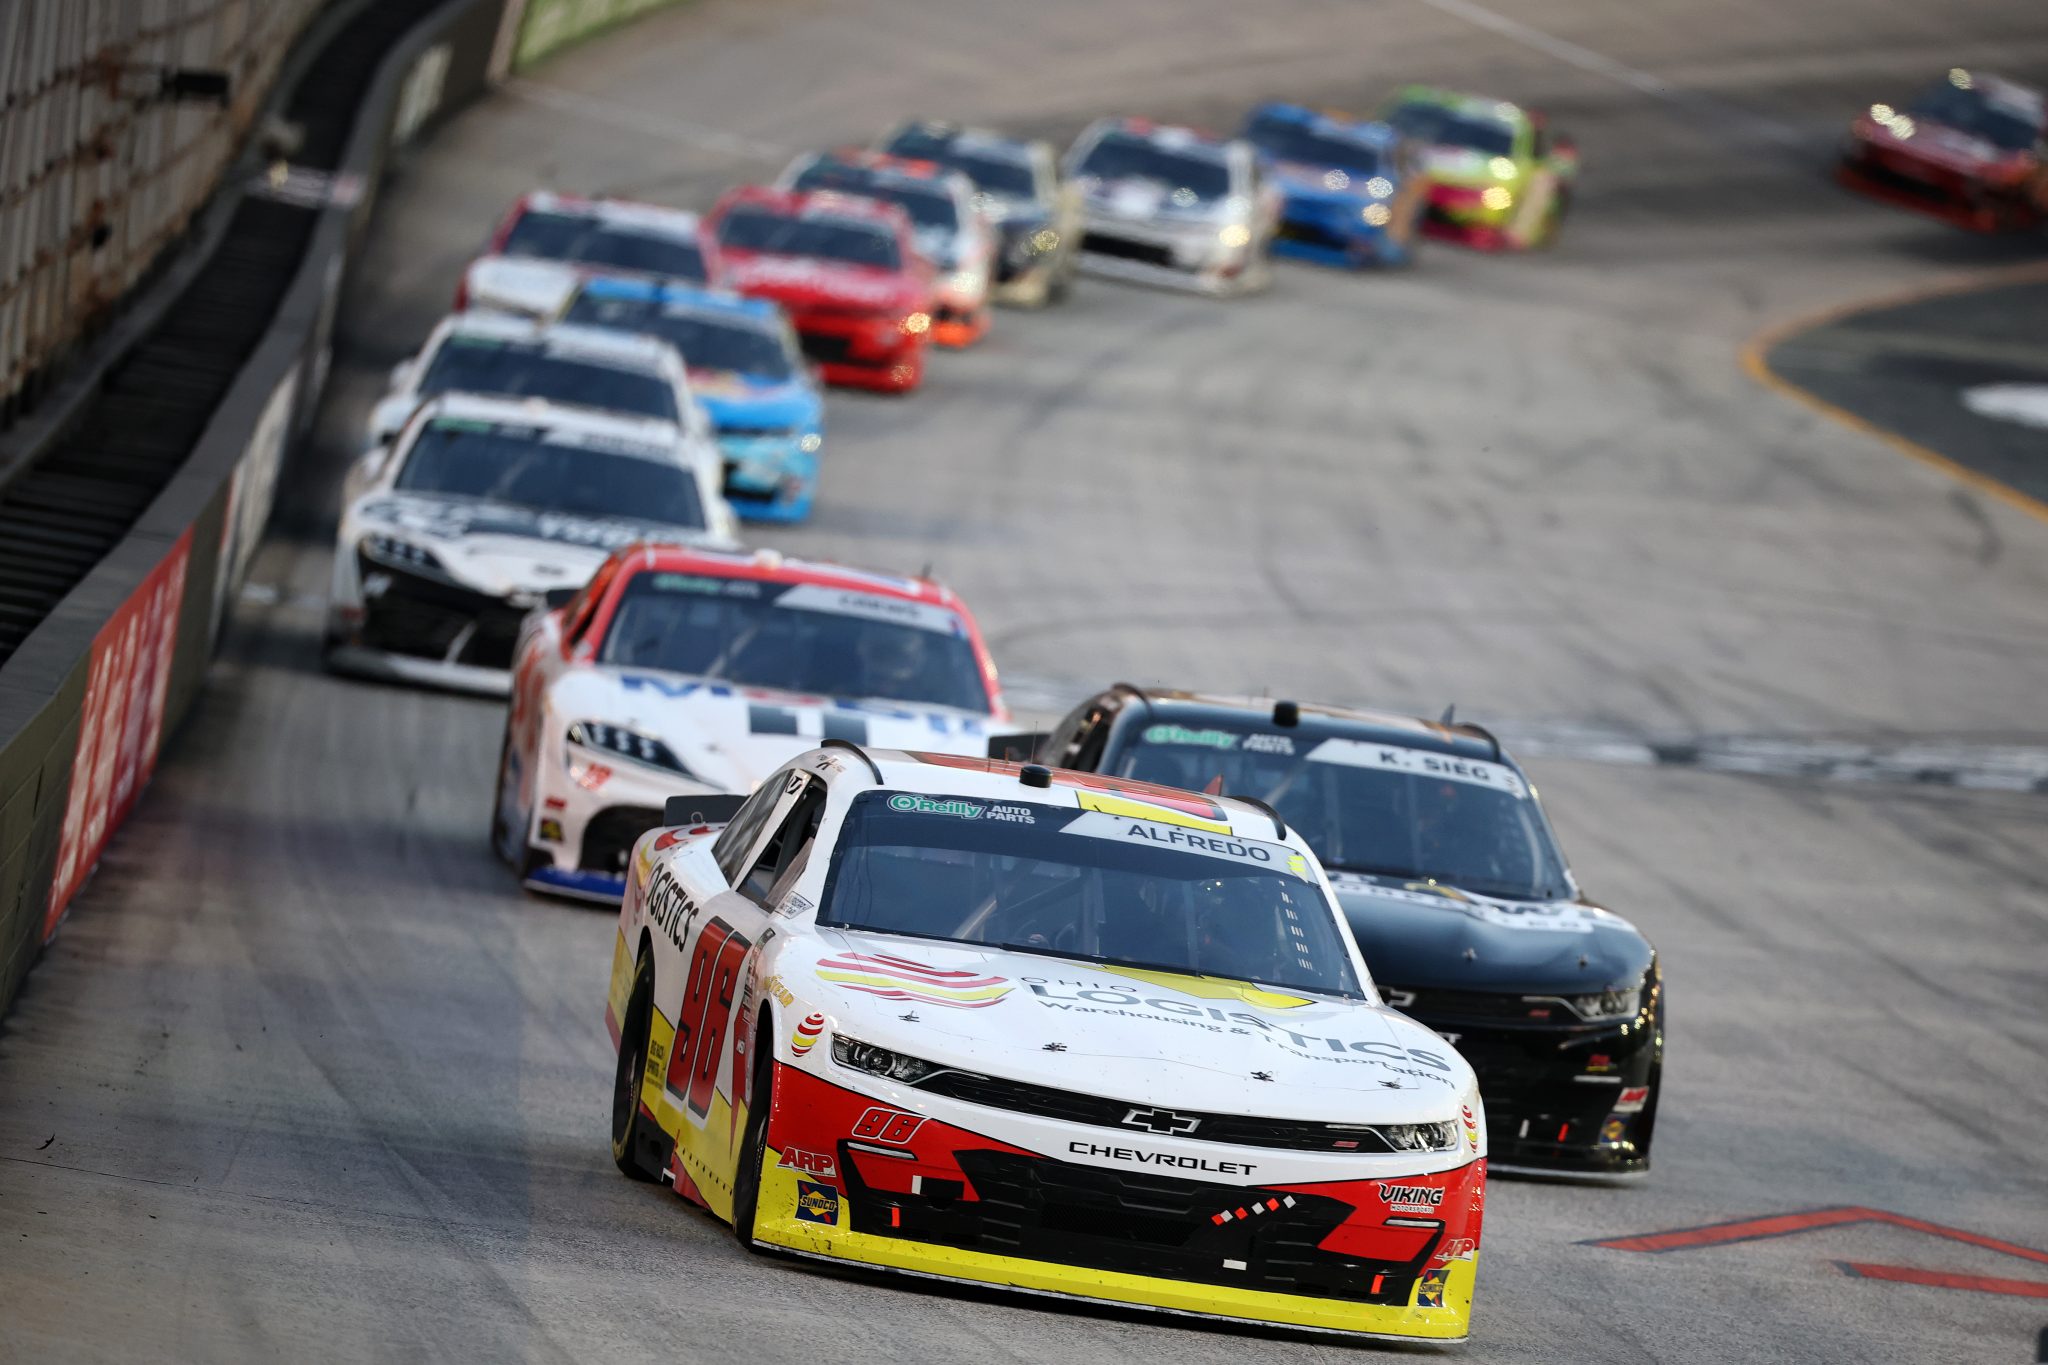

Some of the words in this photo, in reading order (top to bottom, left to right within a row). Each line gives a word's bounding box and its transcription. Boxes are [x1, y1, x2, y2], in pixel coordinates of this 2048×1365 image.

[1424, 757, 1490, 781] SIEG
[888, 795, 984, 818] O'Reilly
[991, 805, 1031, 816] AUTO
[987, 812, 1036, 824] PARTS
[1127, 825, 1270, 861] ALFREDO
[1021, 977, 1137, 992] OHIO
[1030, 985, 1452, 1071] LOGISTICS
[1037, 1000, 1222, 1032] Warehousing
[1229, 1028, 1252, 1036] &
[777, 1147, 836, 1174] ARP
[1069, 1141, 1257, 1175] CHEVROLET
[801, 1196, 837, 1212] SUNOCO
[1379, 1183, 1444, 1205] VIKING
